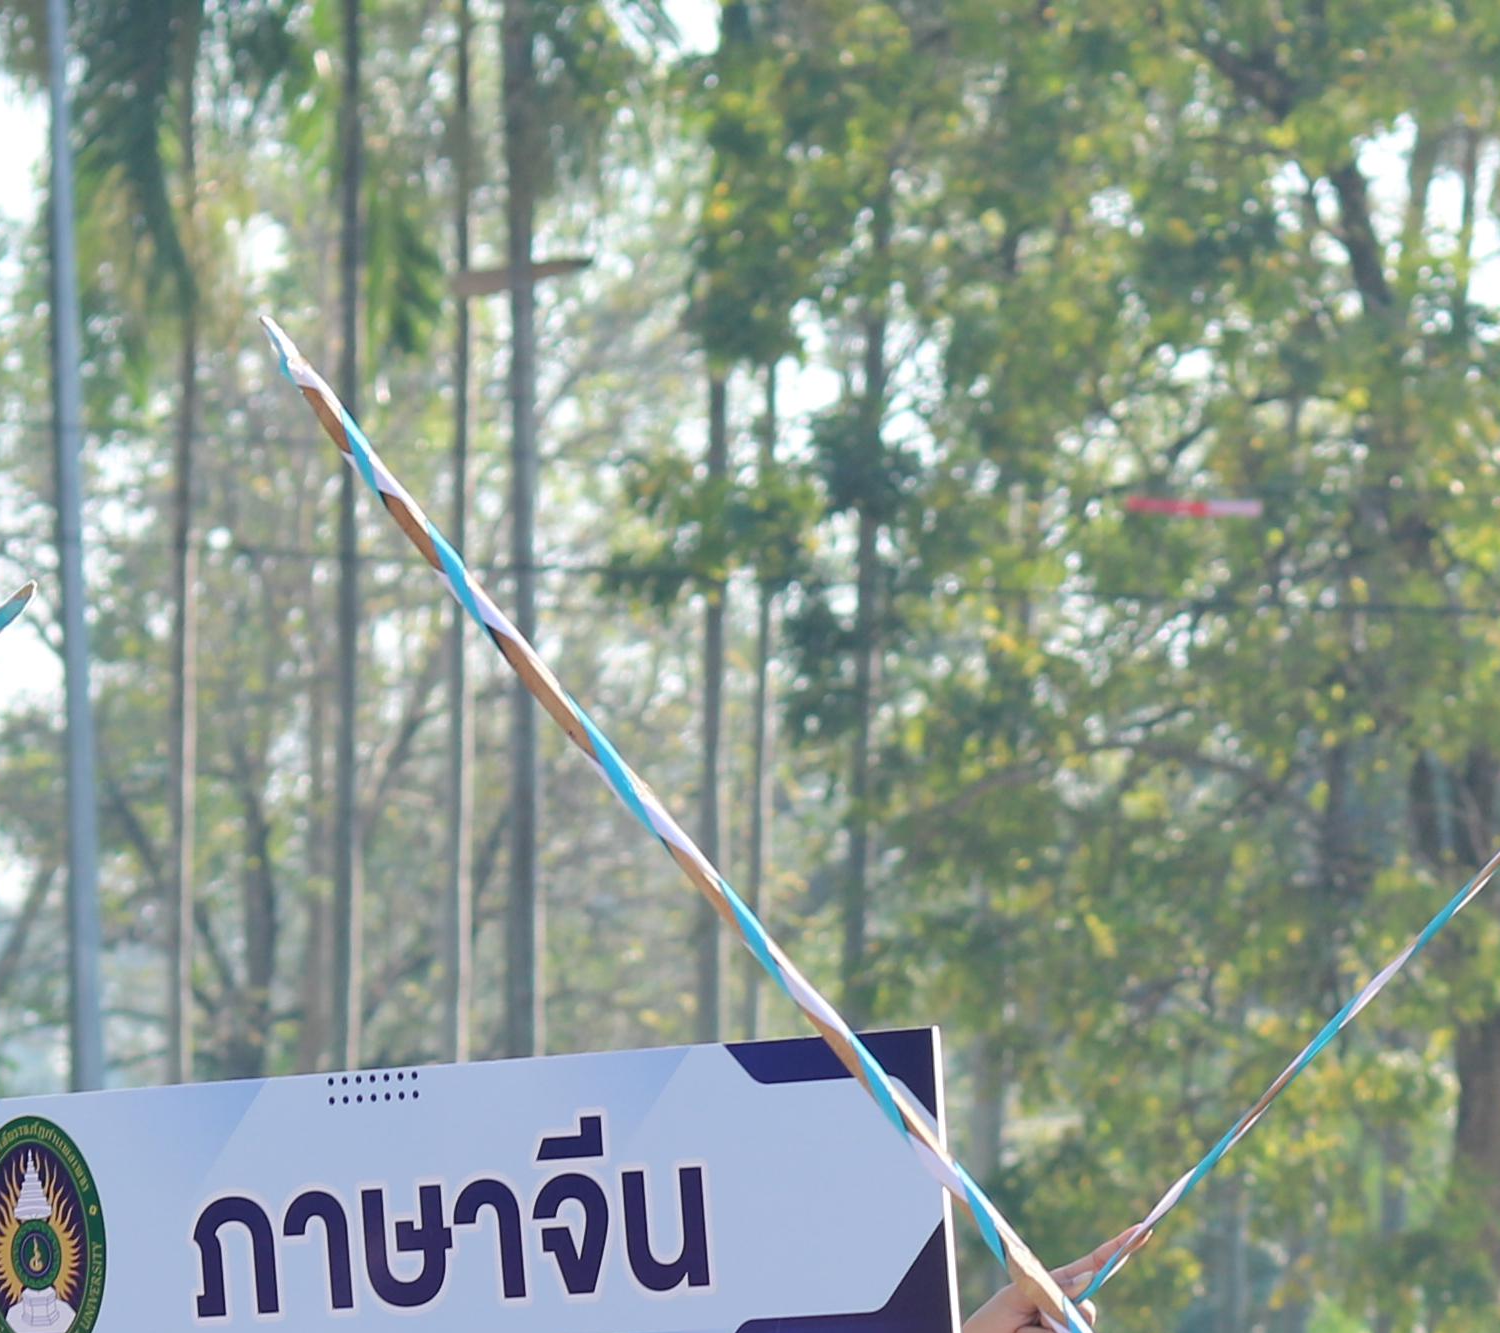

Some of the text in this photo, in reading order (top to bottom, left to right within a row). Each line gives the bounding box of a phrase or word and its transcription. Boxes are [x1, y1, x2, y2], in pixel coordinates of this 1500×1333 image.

[80, 1241, 103, 1330] UNIVERSITY
[192, 1115, 710, 1318] ภาษาจีน
